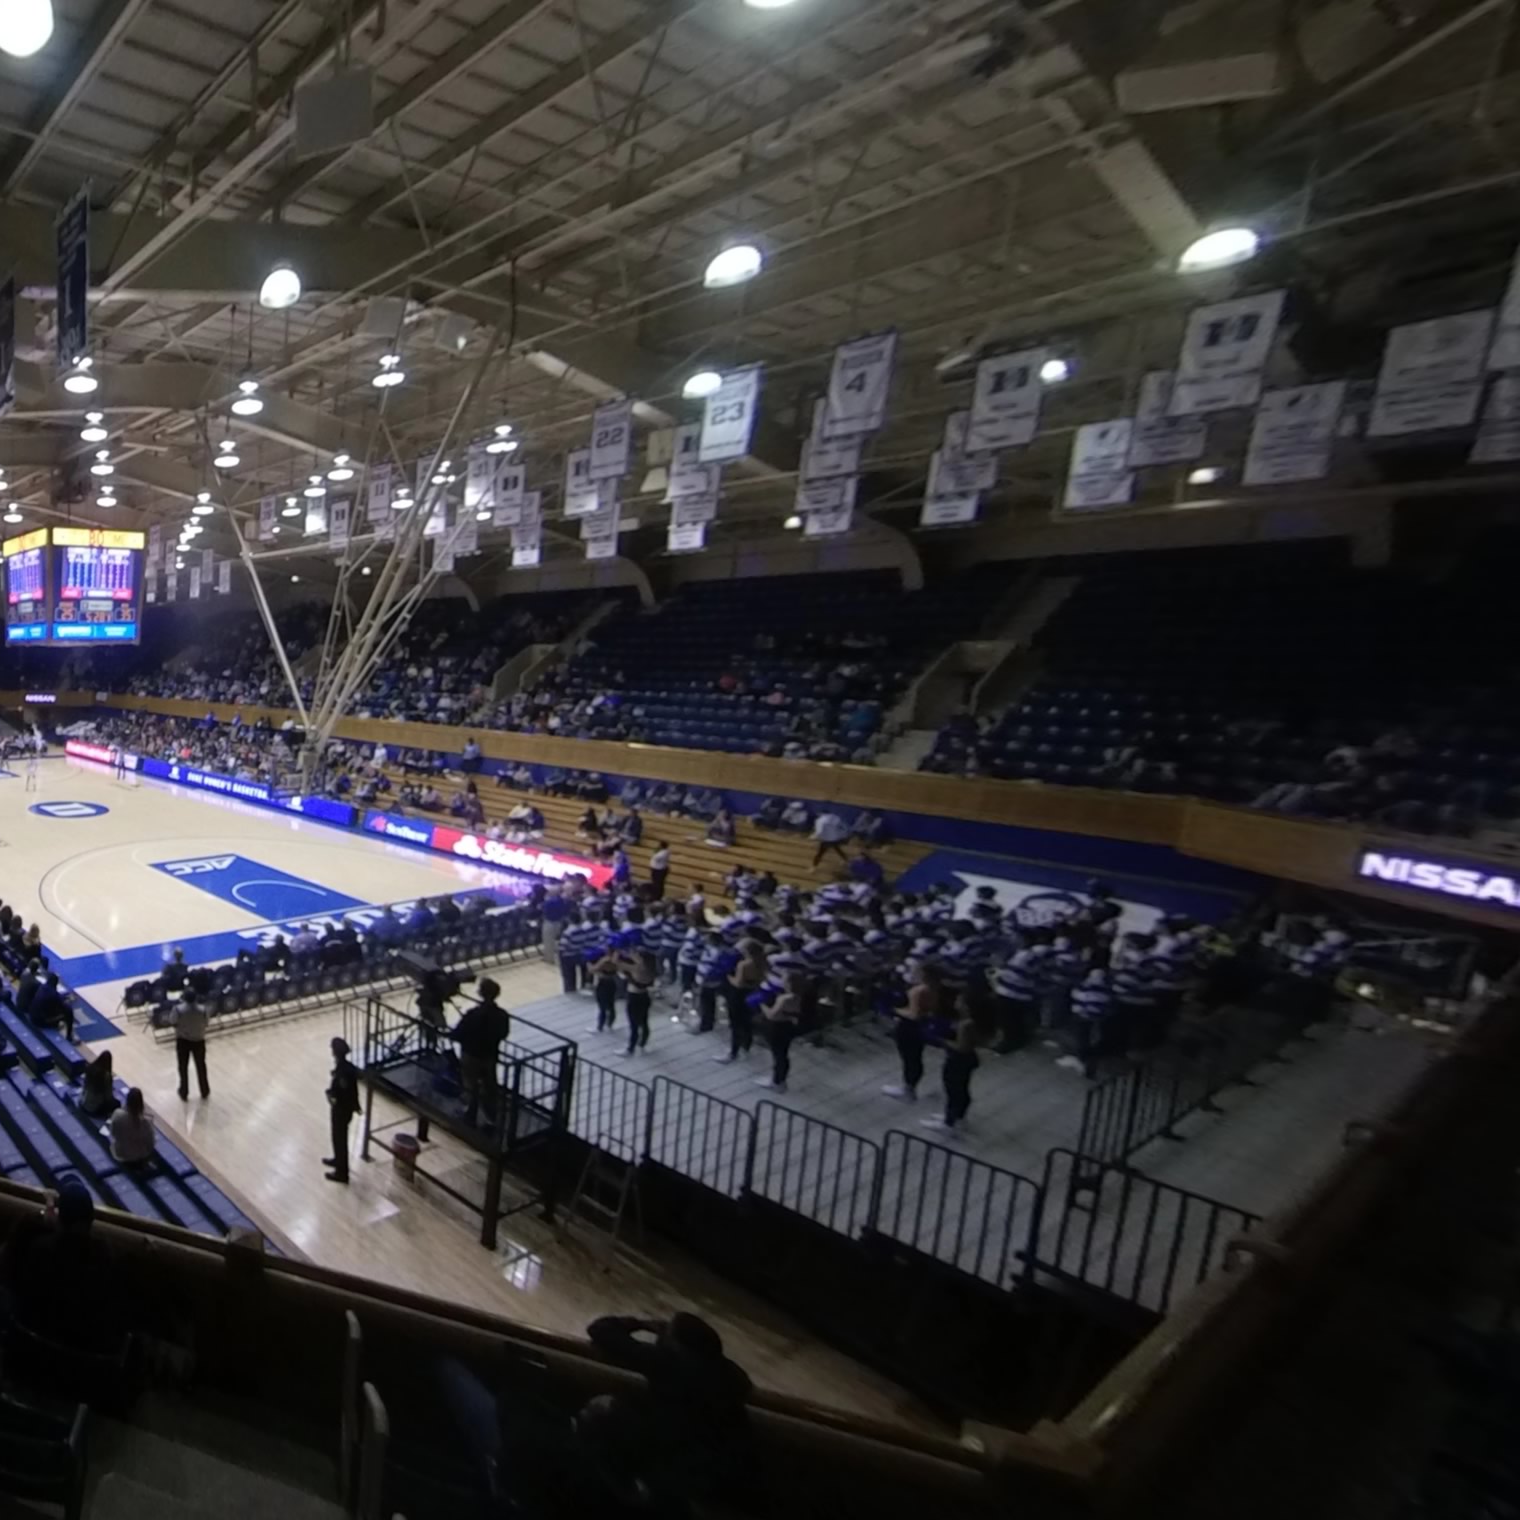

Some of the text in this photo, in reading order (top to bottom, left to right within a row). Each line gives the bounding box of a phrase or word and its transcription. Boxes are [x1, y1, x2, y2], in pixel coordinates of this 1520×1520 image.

[844, 371, 867, 393] 4
[711, 401, 745, 426] 23
[595, 427, 625, 449] 22
[25, 694, 56, 703] NISSAN
[164, 855, 236, 875] ACC
[481, 840, 593, 881] State Farm
[1360, 853, 1520, 907] NISSA
